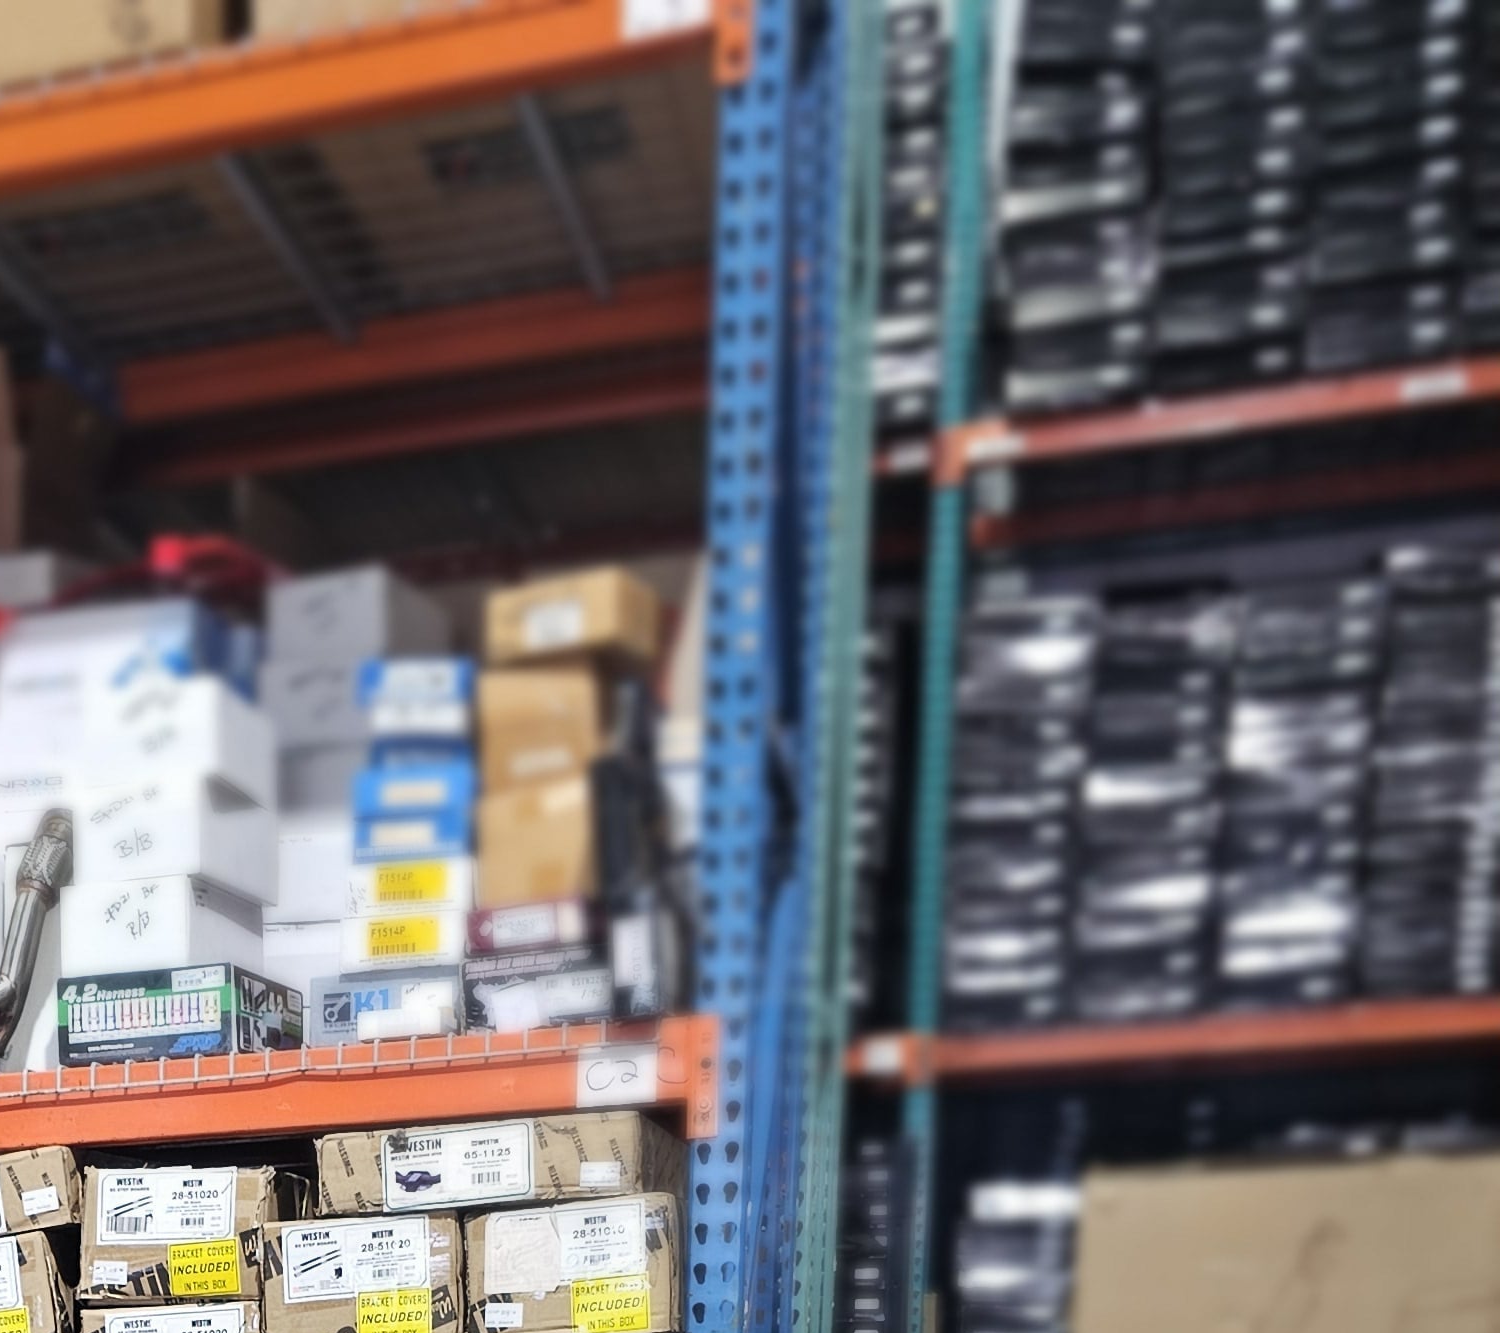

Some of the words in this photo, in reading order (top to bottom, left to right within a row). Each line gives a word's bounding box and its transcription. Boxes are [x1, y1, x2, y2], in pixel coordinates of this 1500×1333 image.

[370, 926, 406, 939] F1514P
[61, 983, 98, 1003] 4.2
[353, 988, 389, 1020] K1
[586, 1059, 639, 1091] C2
[464, 1147, 511, 1160] 65-1125
[116, 1178, 144, 1186] WESTIN
[171, 1190, 219, 1200] 28-51020
[301, 1231, 331, 1241] WESTIN
[371, 1229, 394, 1239] WESTIN
[172, 1248, 203, 1260] BRACKET
[207, 1245, 235, 1256] COVERS
[173, 1260, 235, 1276] INCLUDED!
[184, 1282, 192, 1291] IN
[192, 1281, 209, 1291] THIS
[212, 1280, 227, 1289] BOX
[575, 1283, 609, 1297] BRACKET
[361, 1296, 393, 1308] BRACKET
[398, 1294, 427, 1305] COVERS
[576, 1296, 645, 1313] INCLUDED!
[0, 1314, 26, 1326] COVERS
[191, 1319, 212, 1327] WESTIN
[361, 1310, 427, 1324] INCLUDED!
[587, 1321, 596, 1330] IN
[597, 1319, 616, 1329] THIS
[619, 1316, 636, 1326] BOX
